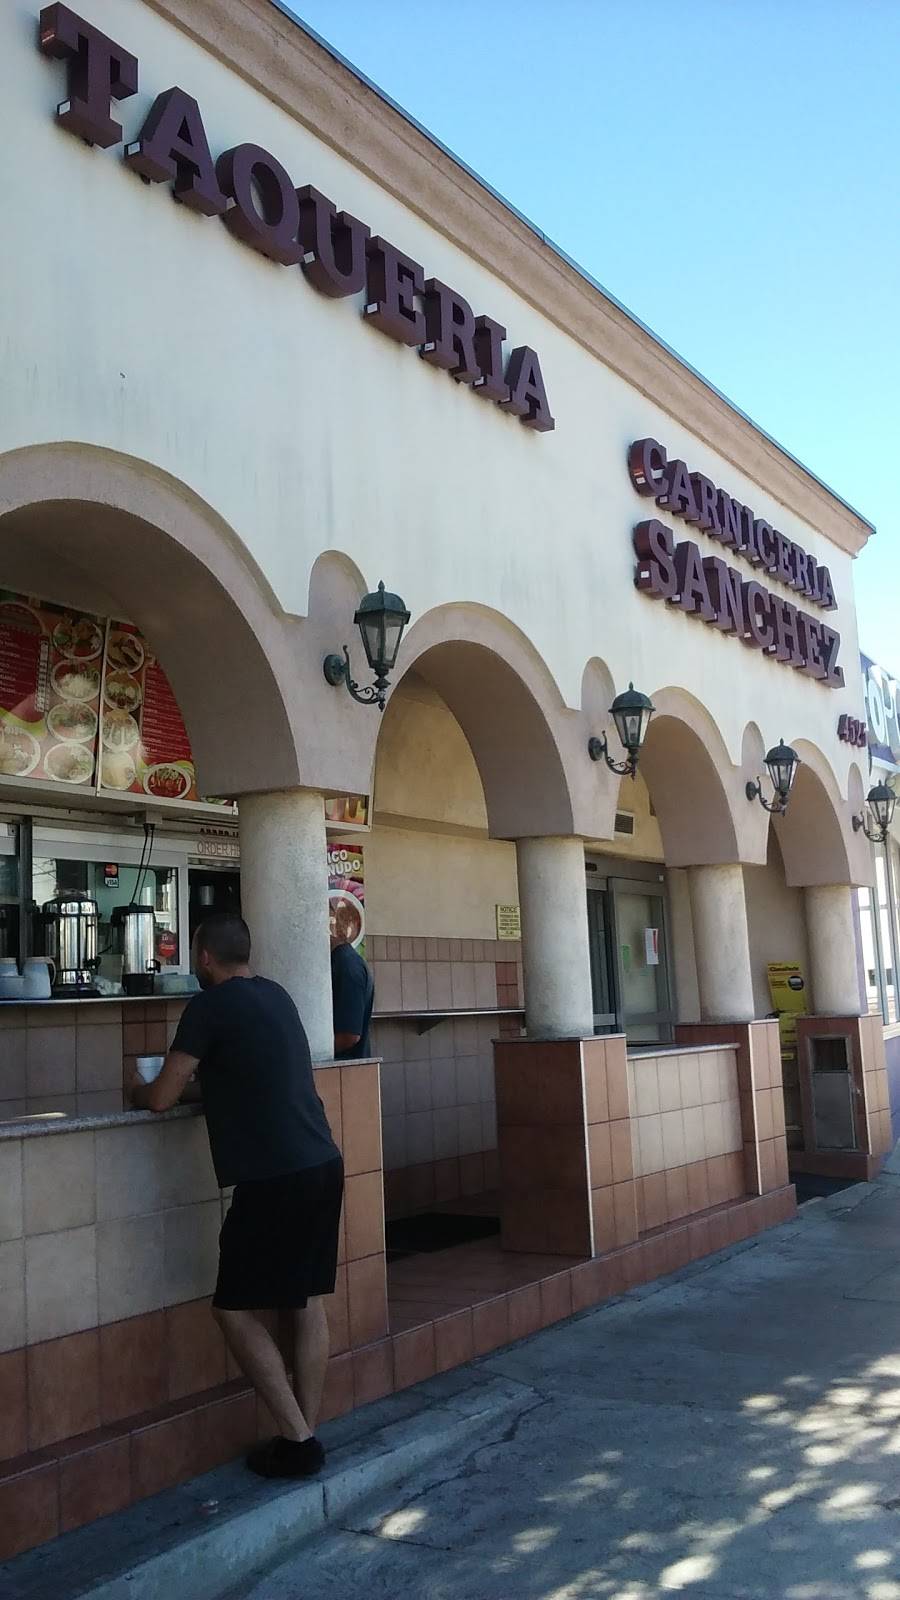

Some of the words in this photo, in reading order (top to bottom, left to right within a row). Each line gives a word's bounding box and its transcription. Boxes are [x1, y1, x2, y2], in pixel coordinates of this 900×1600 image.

[39, 2, 555, 433] TAQUERIA
[628, 437, 838, 611] CARNICERIA
[633, 519, 845, 689] SANCHEZ
[197, 840, 229, 856] ORDER
